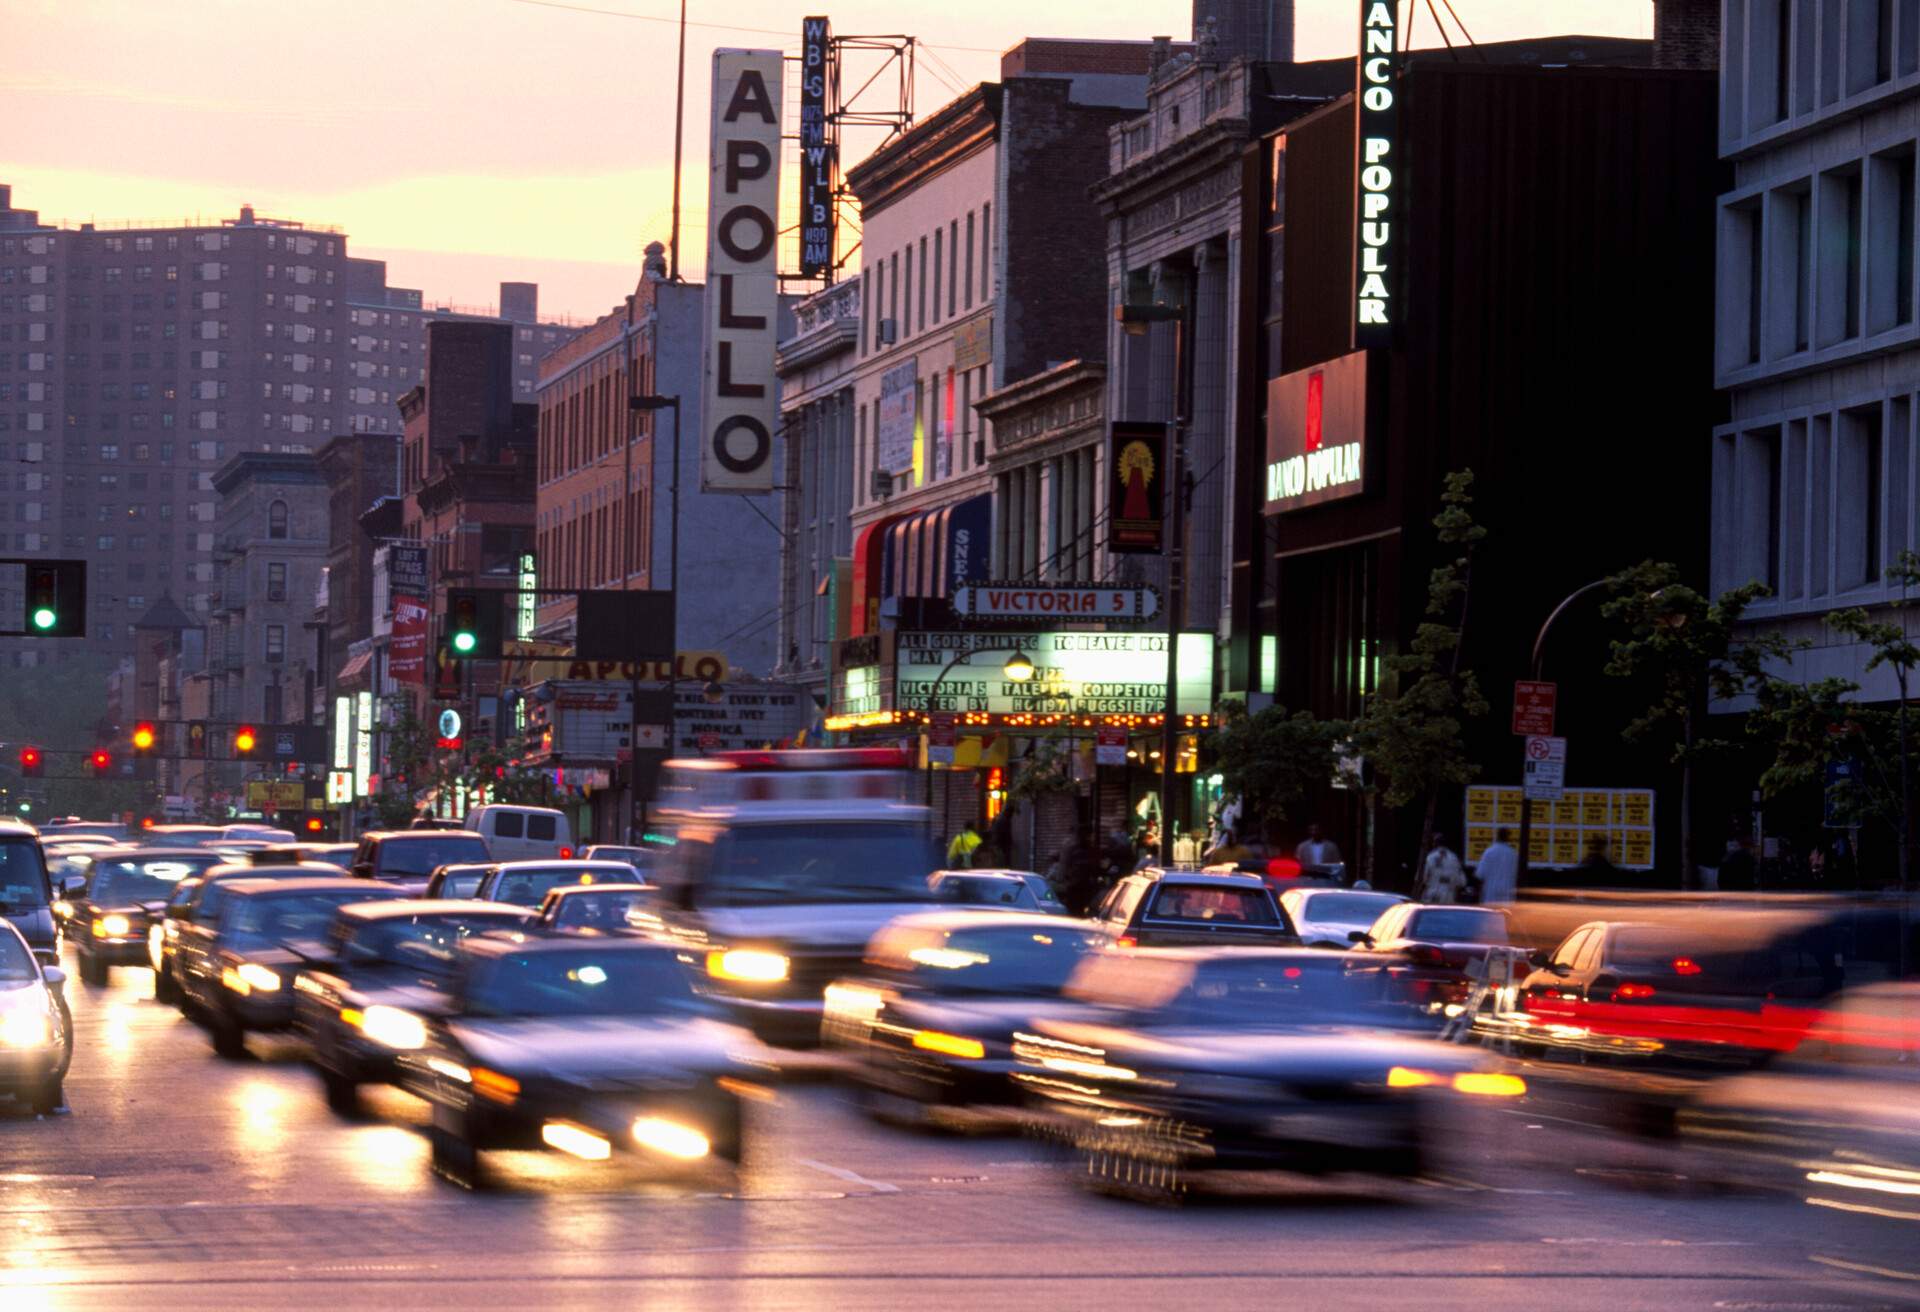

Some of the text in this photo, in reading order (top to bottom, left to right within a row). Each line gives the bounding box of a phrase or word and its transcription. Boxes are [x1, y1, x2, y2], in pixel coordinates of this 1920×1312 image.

[804, 20, 824, 97] WBLS
[803, 122, 822, 144] FM
[808, 148, 827, 222] WLIB
[1359, 138, 1392, 323] POPULAR
[806, 244, 827, 264] AM
[713, 70, 776, 473] APOLLO
[1267, 442, 1360, 501] BANCO POPULAR
[988, 591, 1125, 613] VICTORIA 5
[900, 635, 927, 648] ALL
[932, 635, 970, 648] GODS
[1055, 636, 1074, 650] TO
[910, 650, 941, 664] MAY
[568, 656, 721, 681] APOLLO
[901, 682, 973, 695] VICTORIA
[1083, 683, 1167, 697] COMPETION
[968, 698, 988, 710] BY
[691, 723, 743, 735] MONICA
